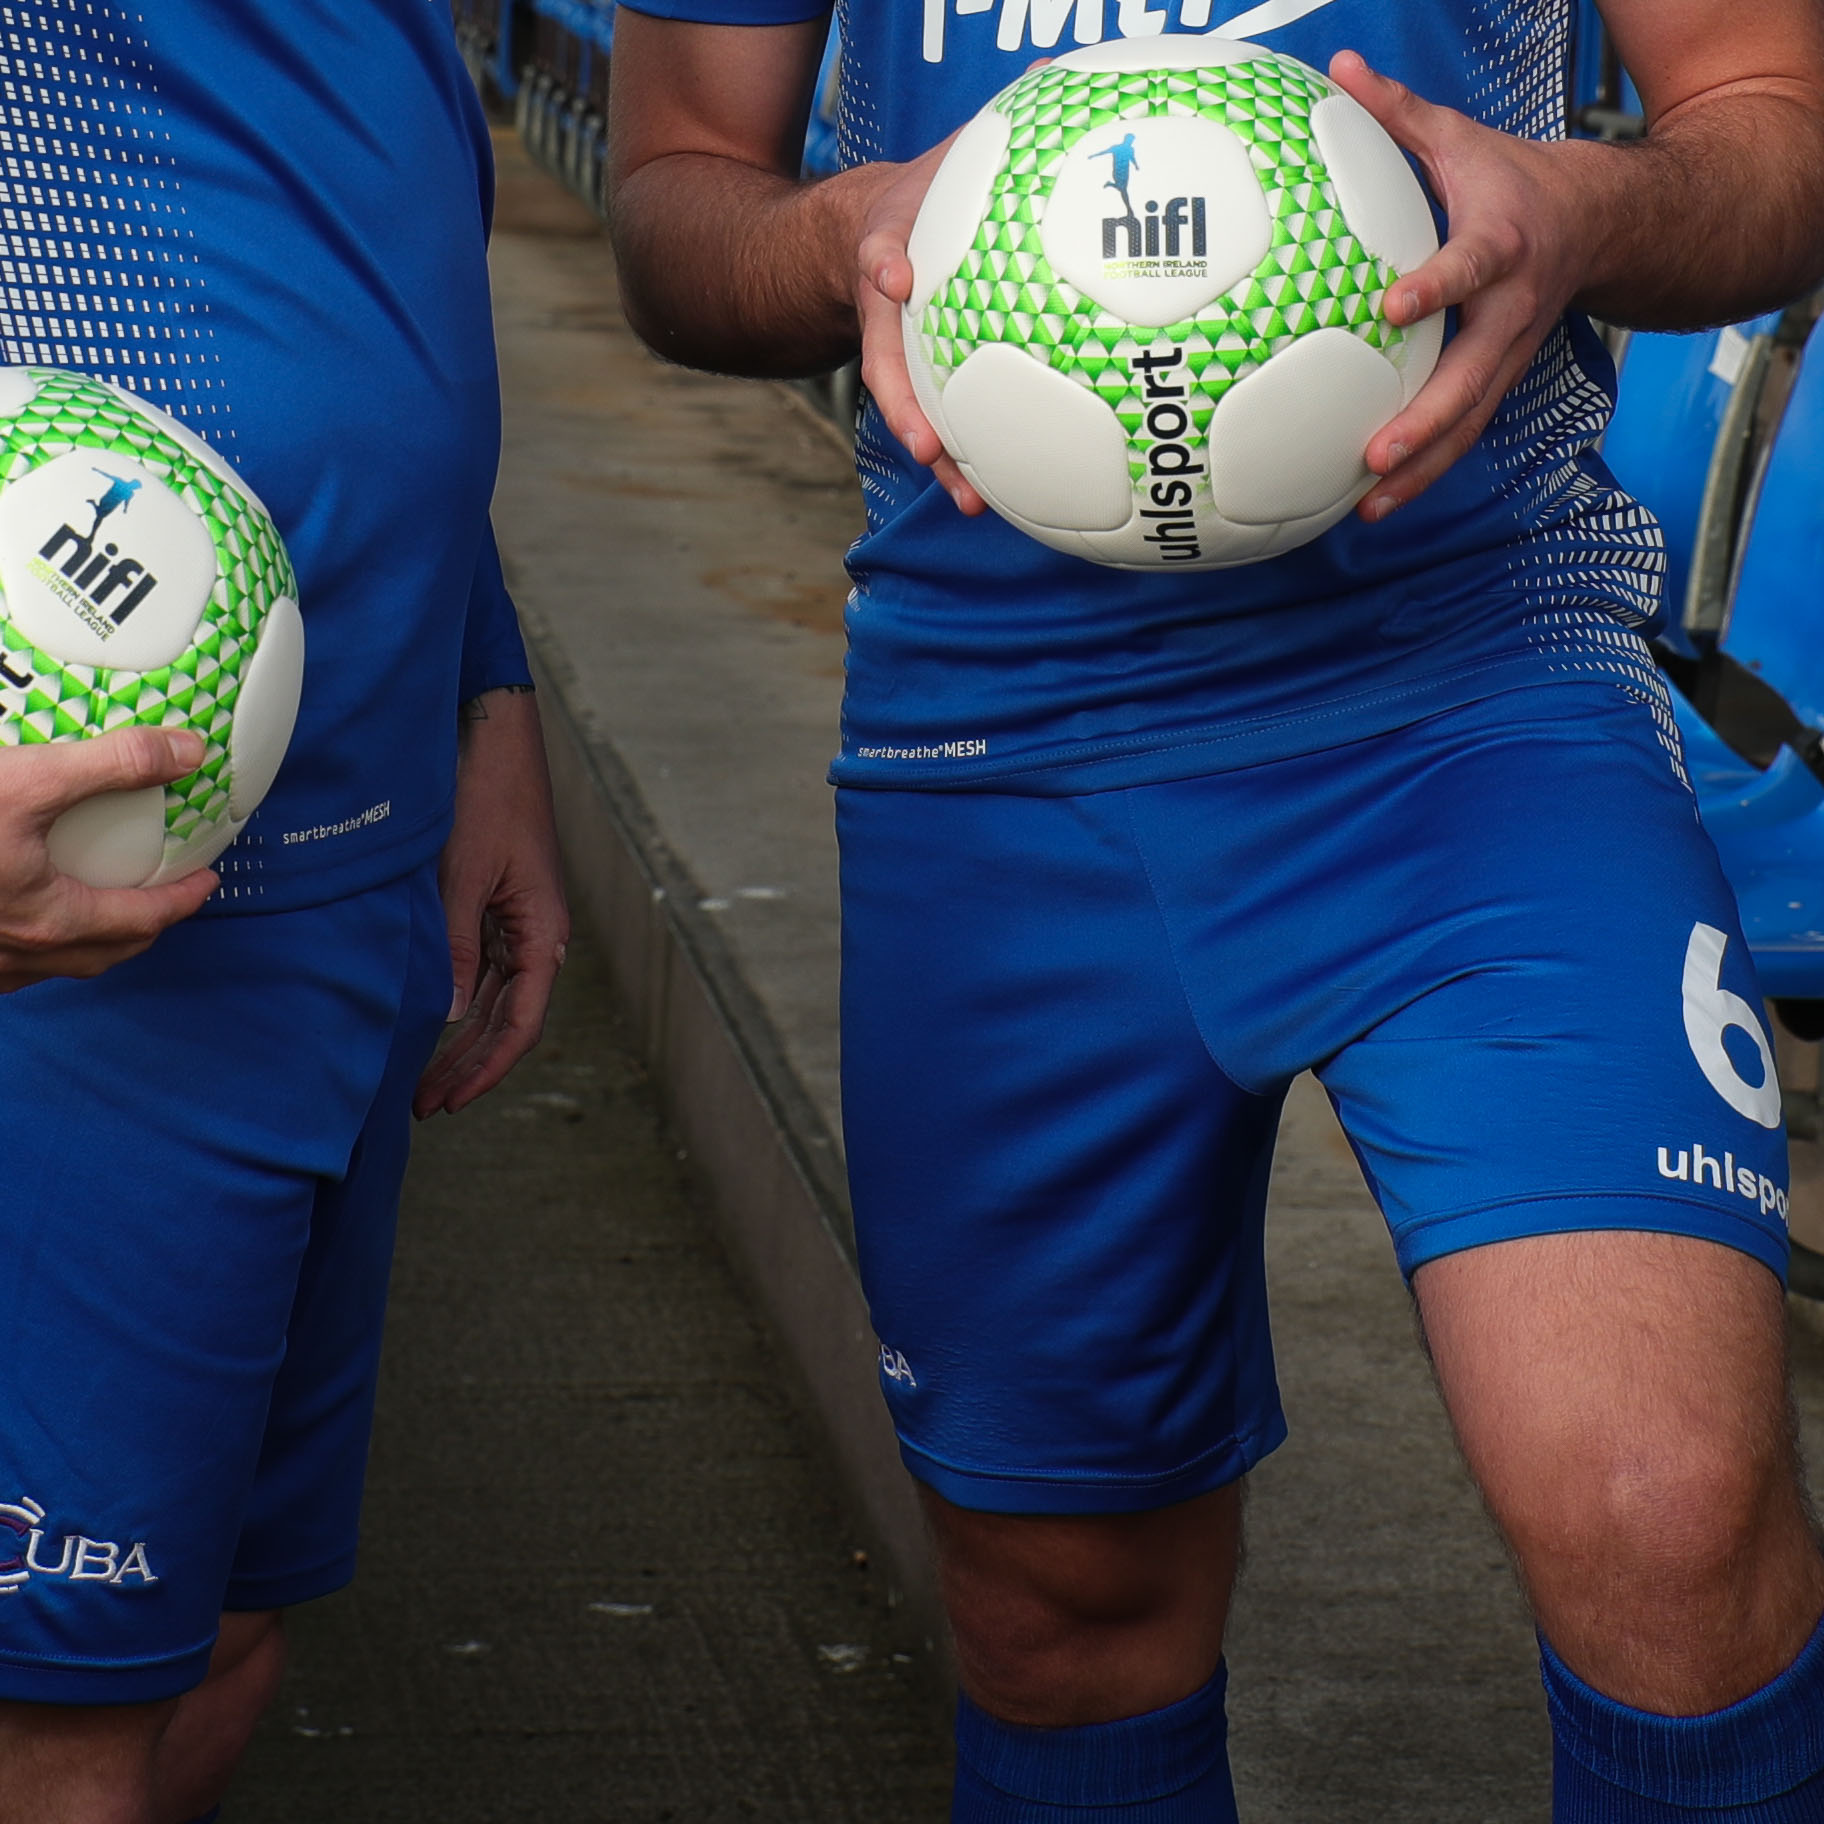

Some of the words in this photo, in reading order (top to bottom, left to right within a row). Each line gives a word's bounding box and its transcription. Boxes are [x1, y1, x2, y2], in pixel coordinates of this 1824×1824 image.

[1101, 196, 1207, 259] nifl
[1162, 260, 1208, 268] IRELAND
[1164, 268, 1209, 278] LEAGUE
[1131, 346, 1206, 562] uhlsport
[37, 522, 158, 626] nifl
[73, 606, 110, 643] LEAGUE
[79, 596, 116, 635] IRELAND
[1682, 921, 1782, 1129] 6
[1657, 1143, 1789, 1228] uhlspo
